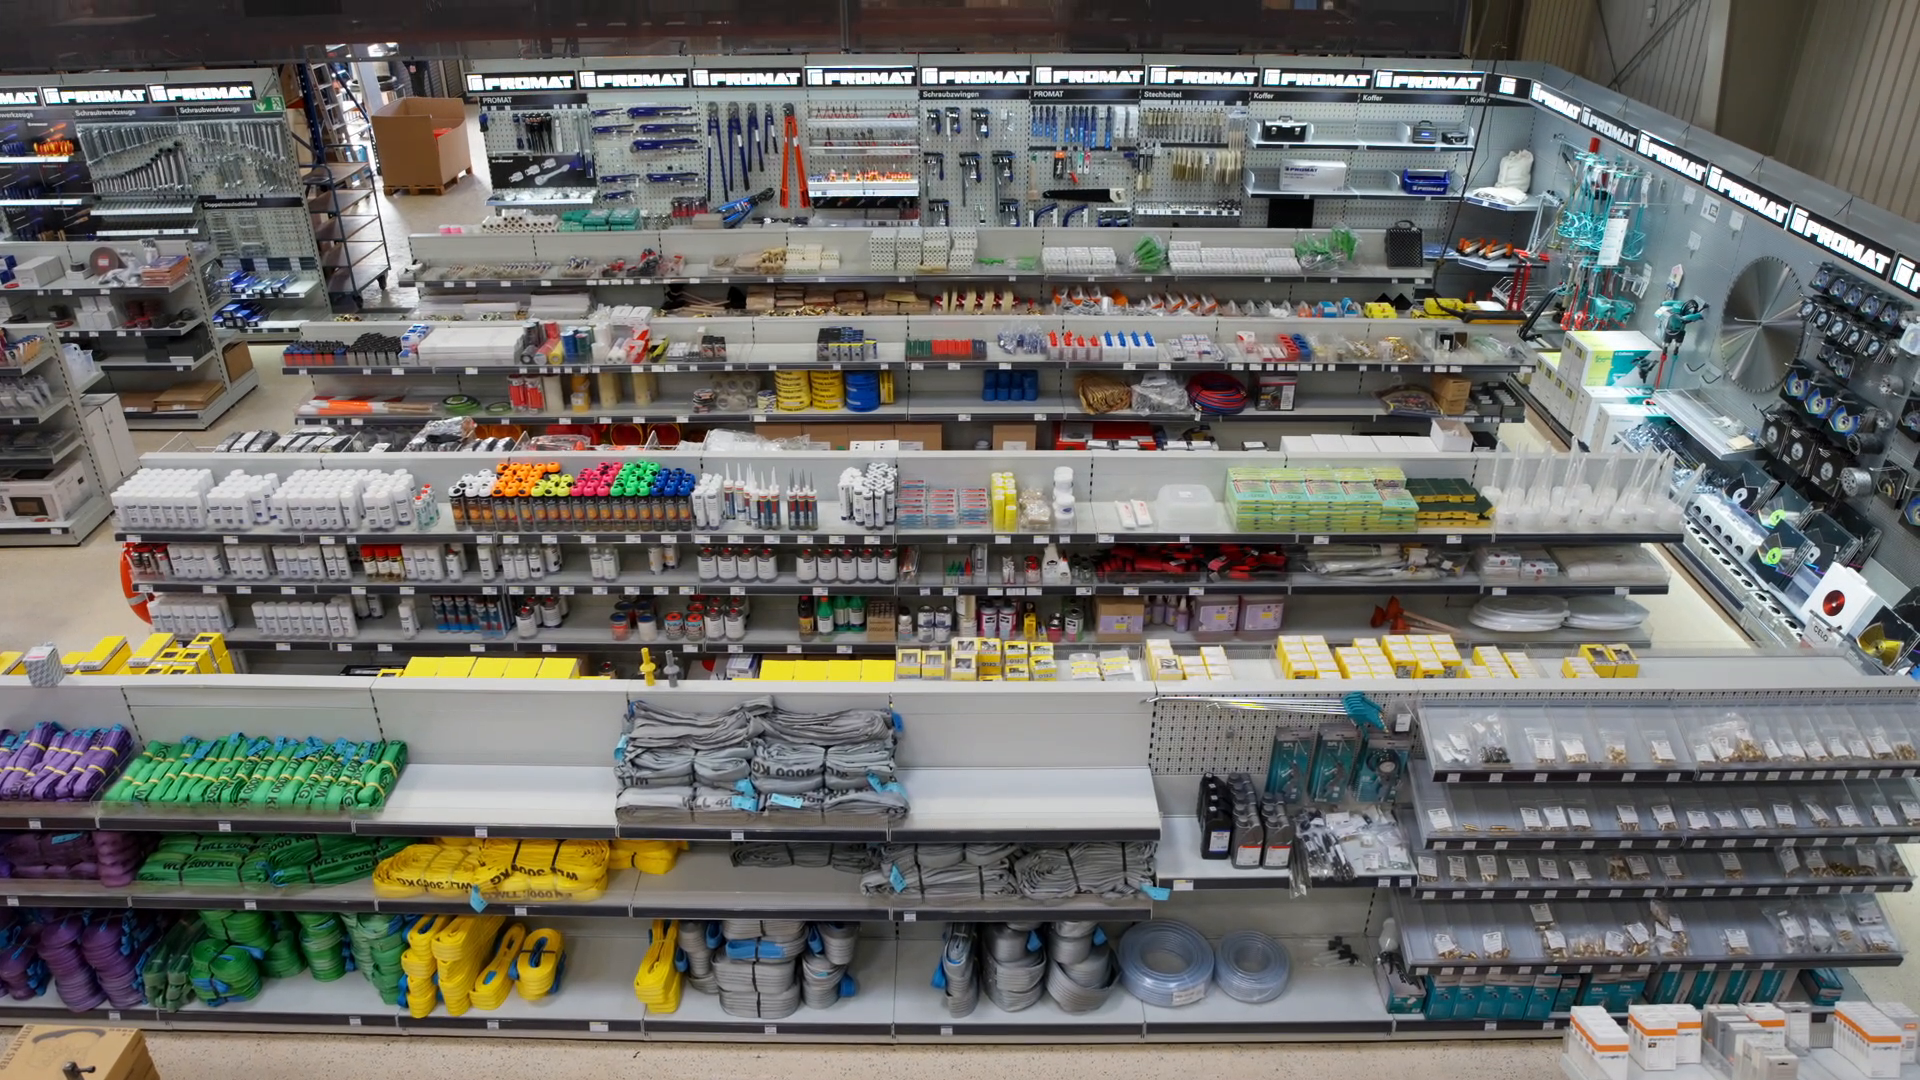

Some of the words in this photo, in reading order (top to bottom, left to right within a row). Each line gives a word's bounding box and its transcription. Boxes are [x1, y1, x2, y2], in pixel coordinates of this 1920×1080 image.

[484, 76, 574, 91] PROMAT
[597, 73, 687, 88] PROMAT
[711, 72, 801, 86] PROMAT
[825, 71, 915, 85] PROMAT
[939, 70, 1030, 85] PROMAT
[1053, 70, 1144, 84] PROMAT
[1167, 71, 1258, 85] PROMAT
[1281, 72, 1370, 88] PROMAT
[1392, 75, 1482, 90] PROMAT
[62, 89, 146, 104] PROMAT
[166, 86, 252, 102] PROMAT
[482, 96, 512, 104] PROMAT
[922, 90, 979, 100] Schraubzwingen
[1033, 90, 1064, 98] PROMAT
[1143, 90, 1183, 99] Stechbeitel
[1253, 92, 1274, 100] Koffer
[1362, 94, 1383, 102] Koffer
[1540, 91, 1582, 120] PROMAT
[1589, 114, 1637, 149] PROMAT
[1648, 142, 1707, 183] PROMAT
[1719, 174, 1789, 224] PROMAT
[1804, 219, 1891, 275] PROMAT
[1813, 625, 1829, 642] CELO
[753, 761, 771, 776] KG
[10, 1025, 34, 1051] UTILITY
